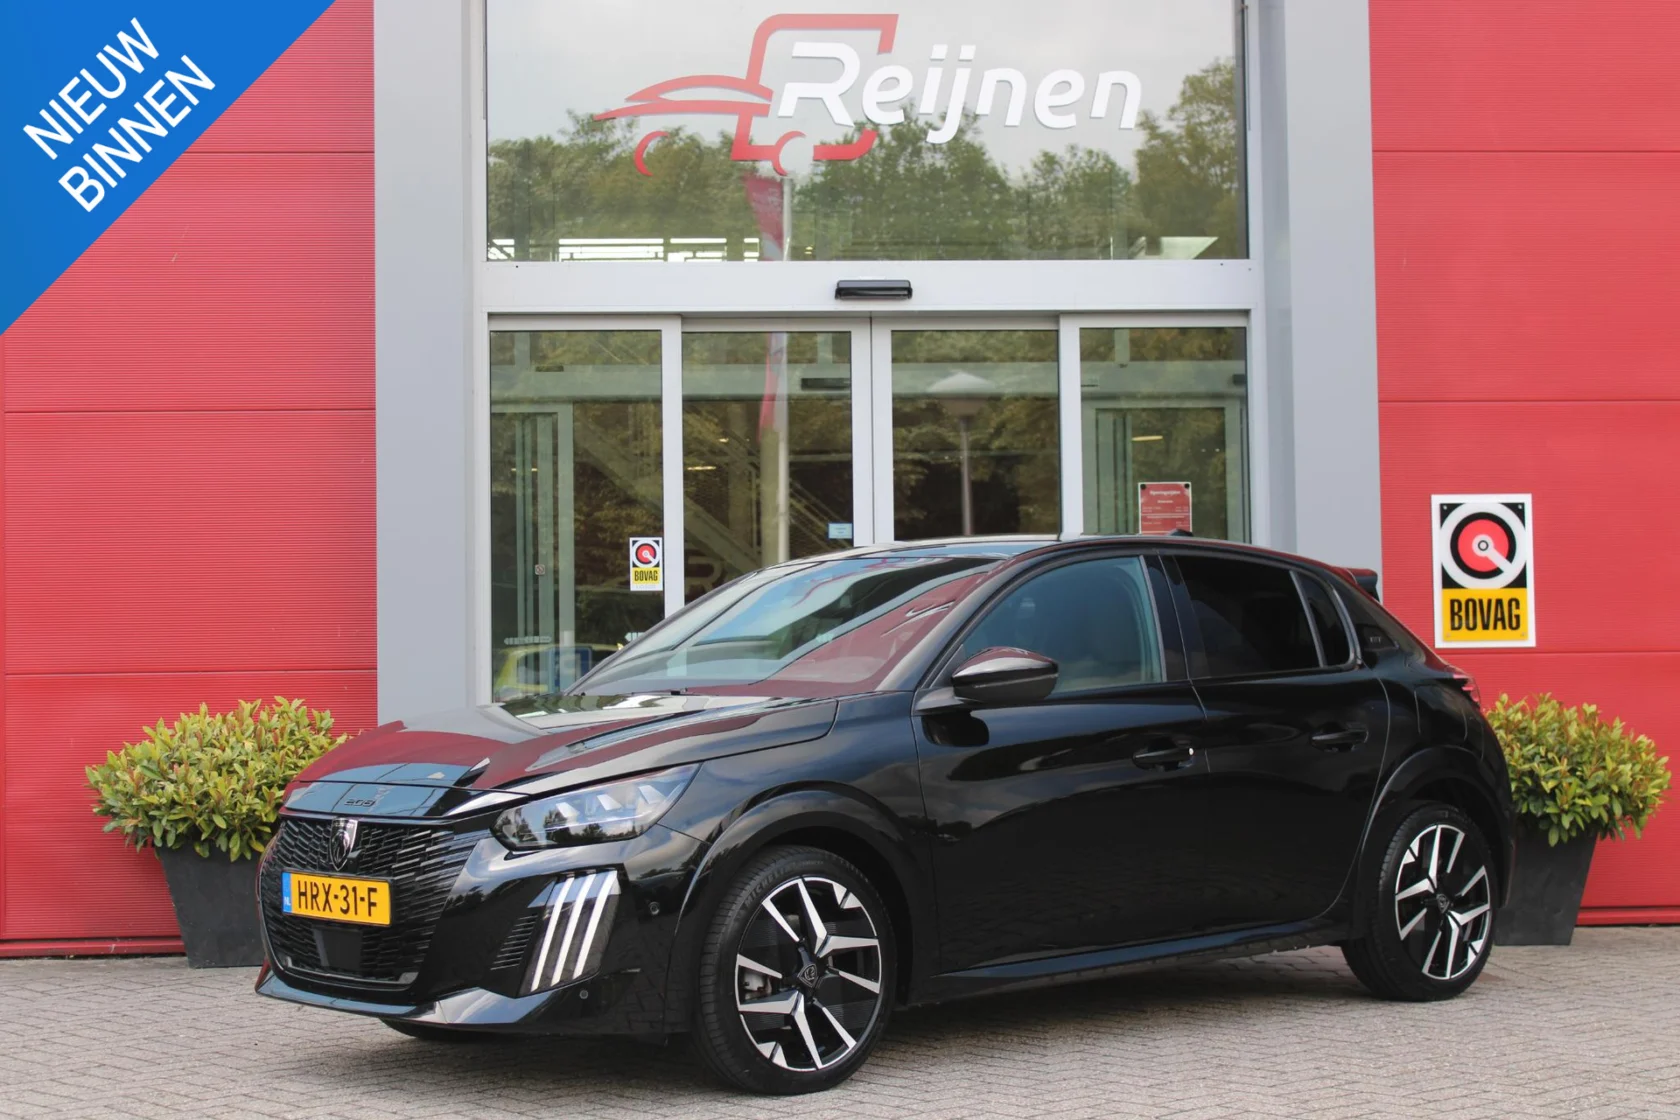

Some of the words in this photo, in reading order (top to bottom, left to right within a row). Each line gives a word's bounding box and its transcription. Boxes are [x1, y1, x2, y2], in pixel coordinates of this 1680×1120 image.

[777, 42, 1142, 144] Reijnen
[634, 570, 659, 582] BOVAG
[1449, 598, 1521, 631] BOVAG
[297, 880, 378, 917] HRX-31-F
